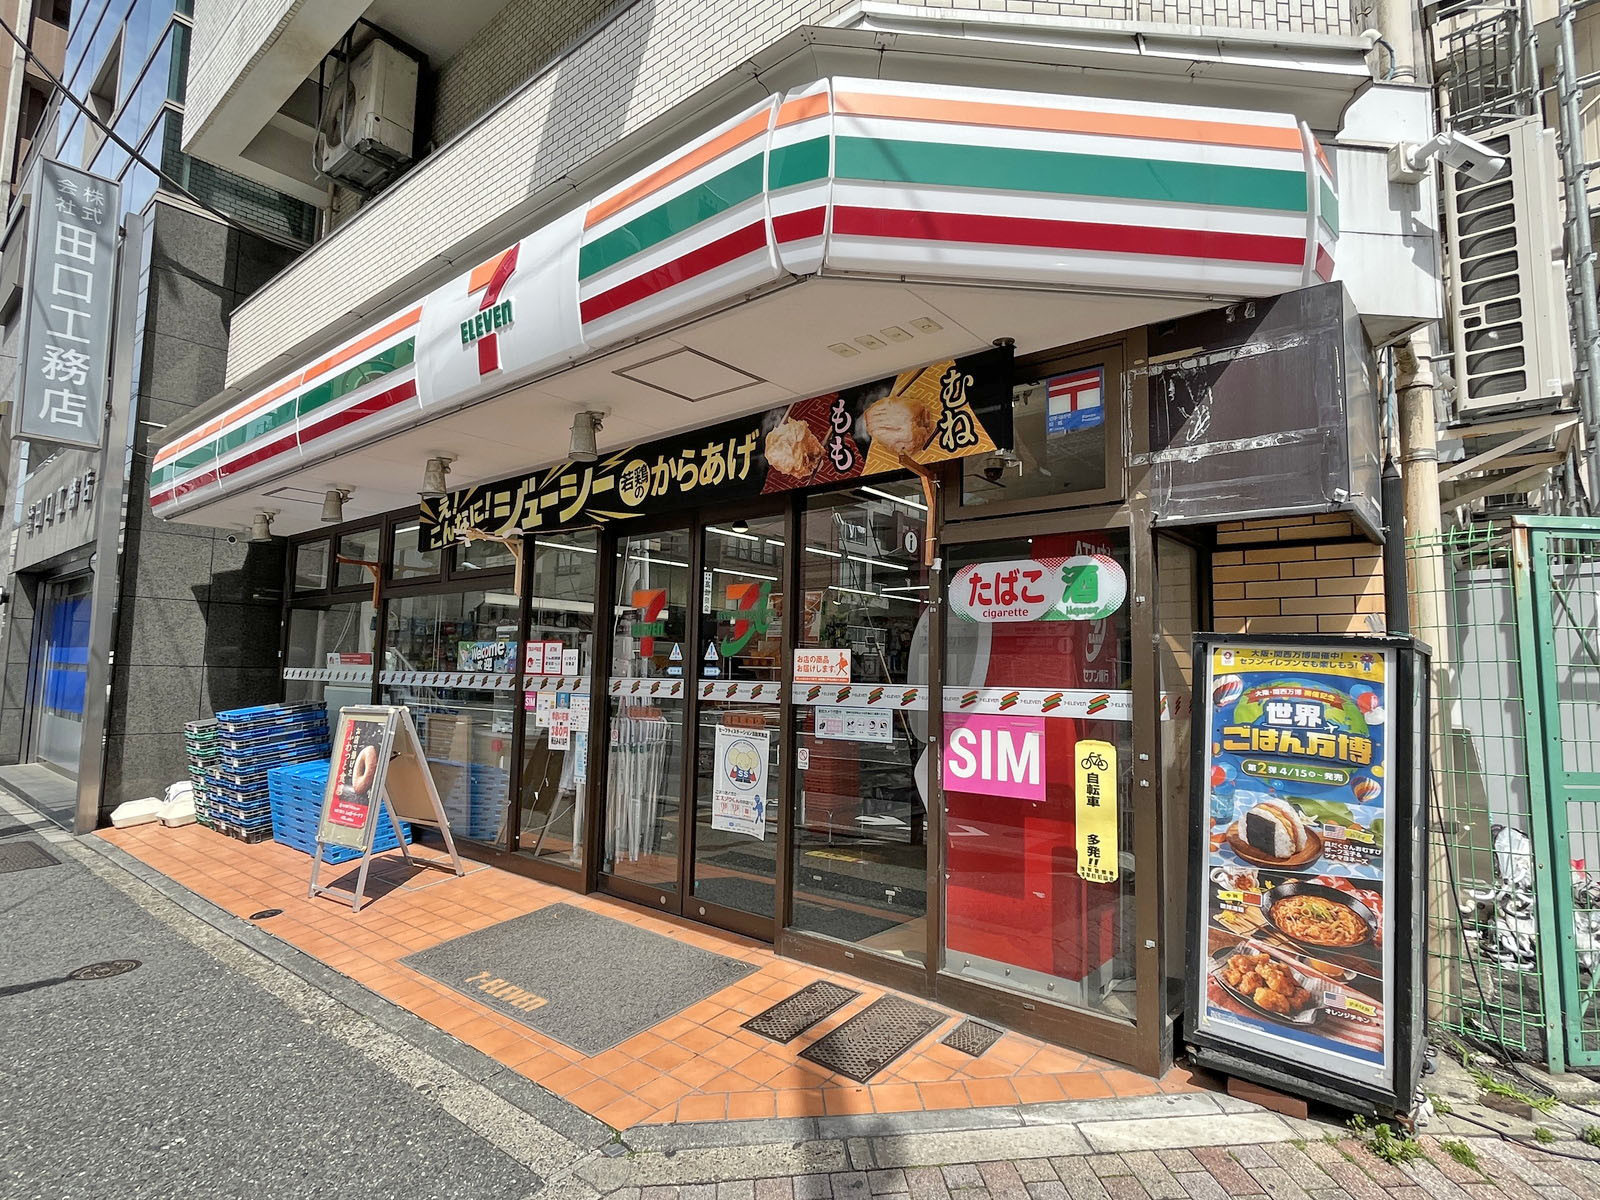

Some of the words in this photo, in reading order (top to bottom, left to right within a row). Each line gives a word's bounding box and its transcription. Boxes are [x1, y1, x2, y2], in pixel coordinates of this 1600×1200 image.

[38, 220, 97, 428] 田口工務店
[941, 370, 975, 449] むね
[831, 399, 852, 470] もも
[431, 492, 491, 549] こんなに!
[494, 467, 614, 536] ジューシー
[621, 464, 649, 498] 若鶏の
[651, 428, 760, 497] からあげ
[439, 492, 459, 523] え!
[968, 568, 1045, 606] たばこ
[1062, 565, 1099, 603] 酒
[982, 607, 1029, 619] cigarette
[1267, 703, 1322, 727] 世界
[948, 727, 1040, 785] SIM
[1222, 726, 1373, 766] ごはん万博
[1086, 772, 1101, 807] 自転車
[1325, 1008, 1370, 1023] オレンジチキン
